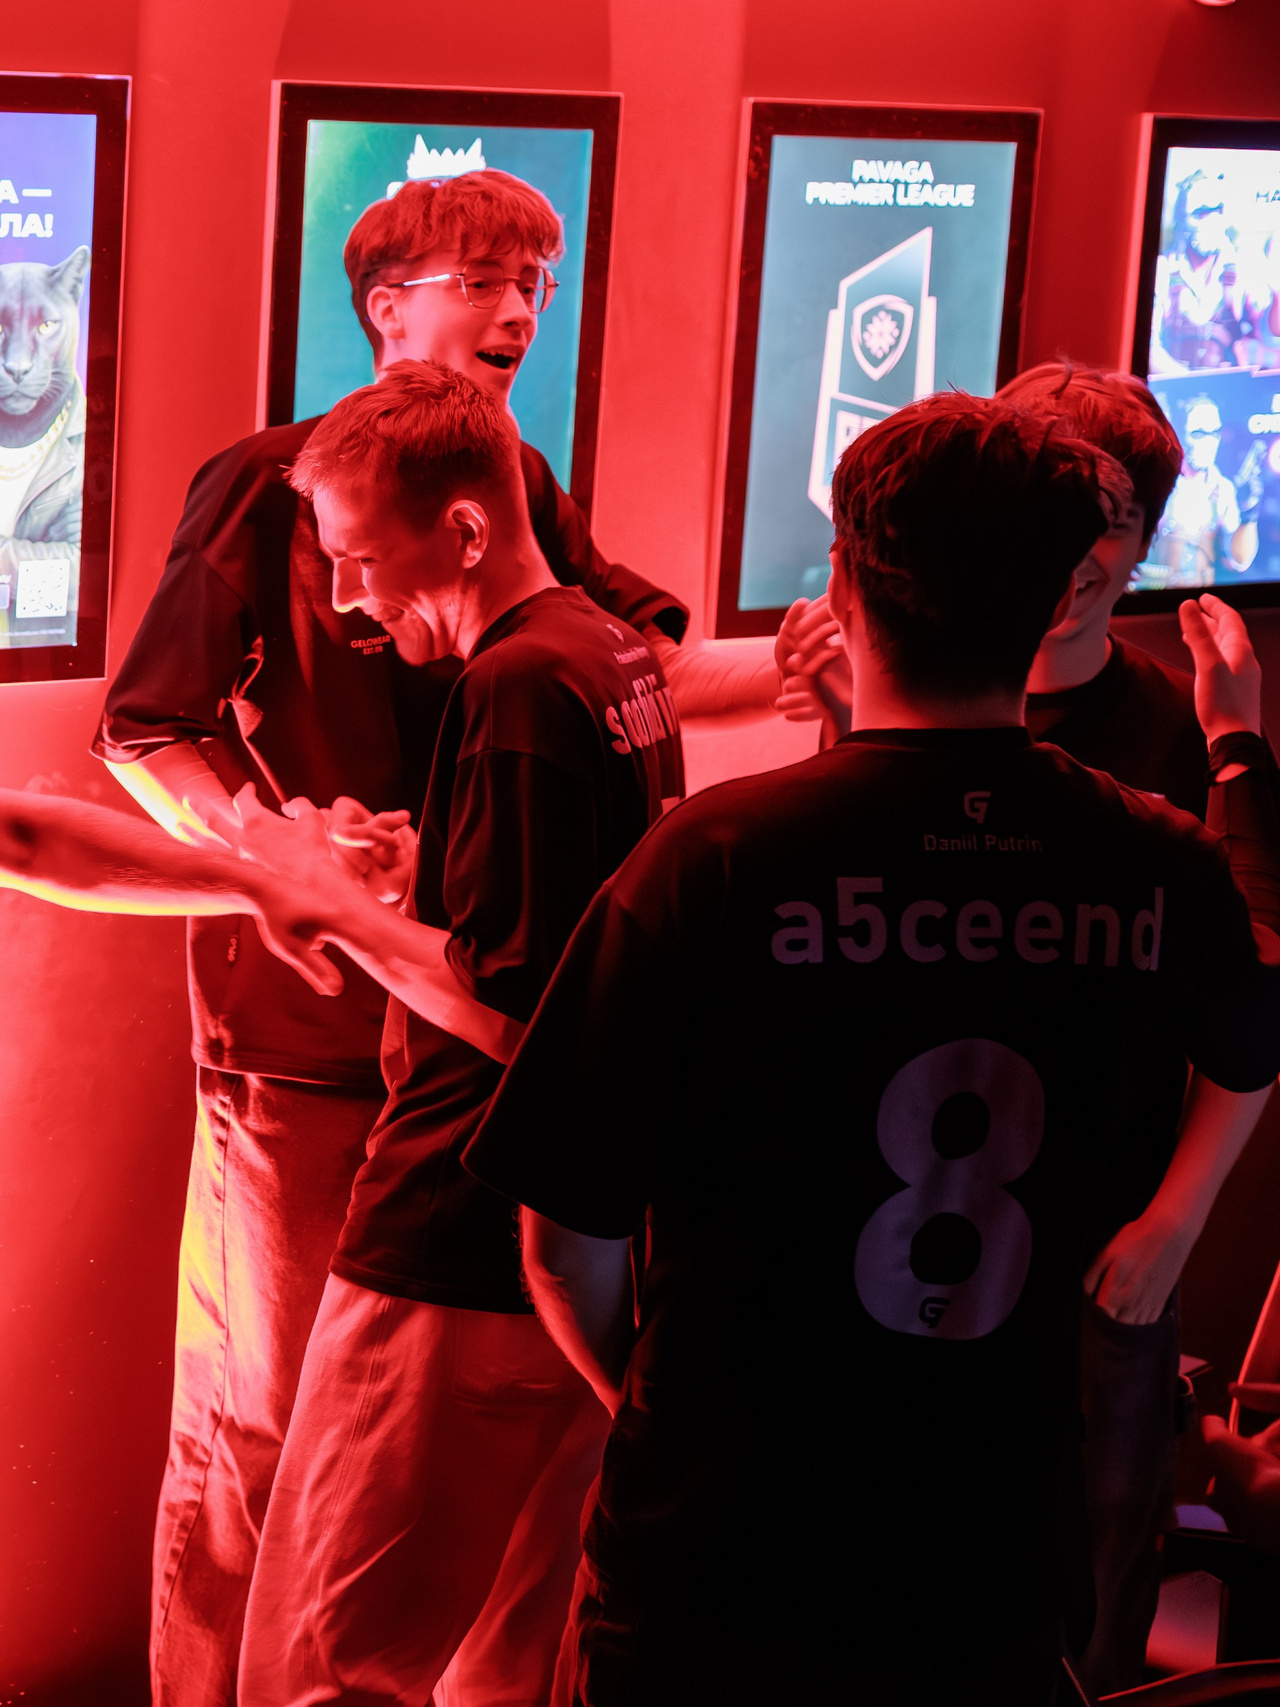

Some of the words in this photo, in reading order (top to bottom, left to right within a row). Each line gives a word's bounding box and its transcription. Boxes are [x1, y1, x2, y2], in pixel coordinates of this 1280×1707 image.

[852, 160, 934, 183] PAVAGA
[805, 181, 895, 206] PREMIER
[895, 183, 976, 207] LEAGUE
[923, 833, 979, 852] Daniil
[983, 833, 1044, 852] Putrin
[770, 875, 1165, 972] a5ceend
[854, 1037, 1046, 1340] 8
